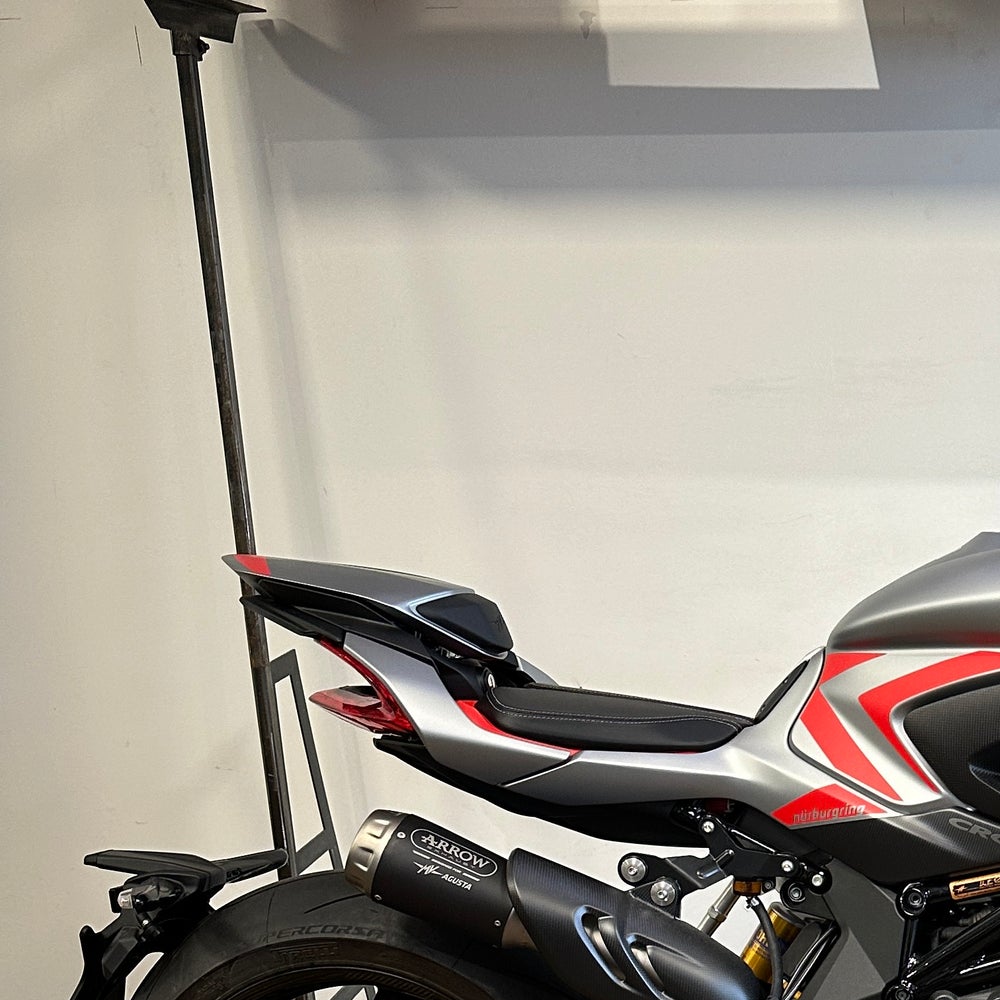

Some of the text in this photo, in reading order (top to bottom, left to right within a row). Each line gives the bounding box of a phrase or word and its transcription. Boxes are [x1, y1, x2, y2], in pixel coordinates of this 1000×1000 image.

[793, 803, 866, 824] nürburgring
[421, 834, 491, 868] ARROW
[441, 873, 474, 891] AGUSTA
